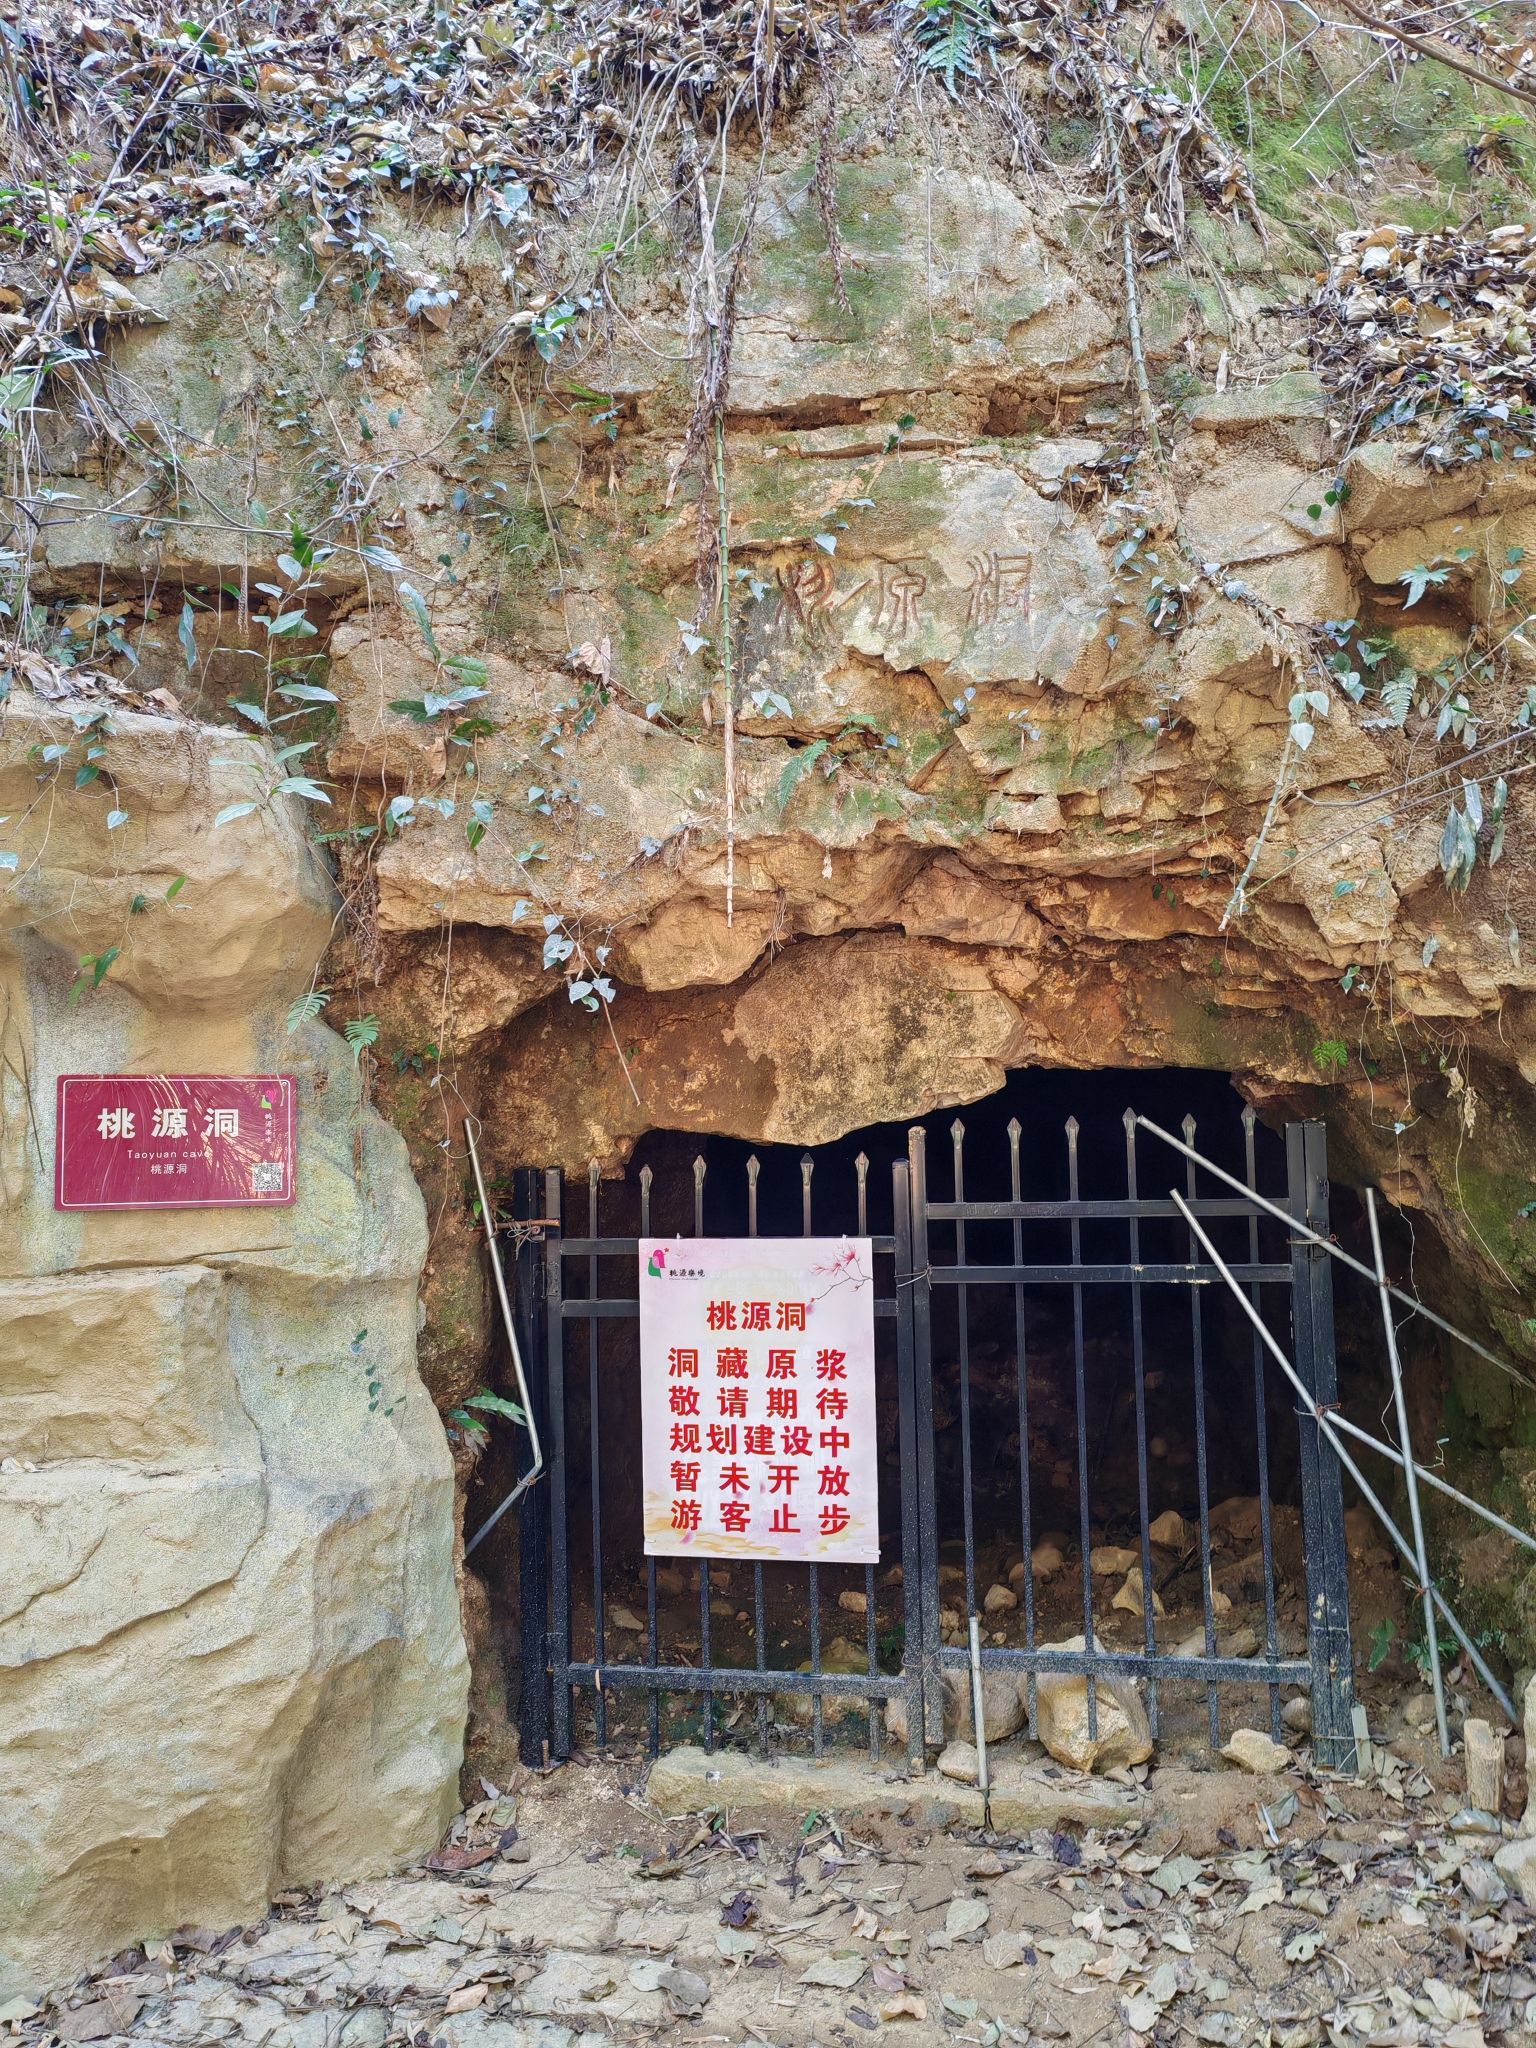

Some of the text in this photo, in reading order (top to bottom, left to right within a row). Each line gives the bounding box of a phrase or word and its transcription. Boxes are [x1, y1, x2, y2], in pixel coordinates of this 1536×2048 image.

[97, 1107, 239, 1139] 桃源洞
[127, 1149, 177, 1160] Taoyuan
[150, 1163, 187, 1174] 桃源洞
[706, 1301, 807, 1331] 桃源洞
[668, 1347, 848, 1380] 洞藏原浆
[668, 1385, 849, 1420] 敬请期待
[670, 1422, 851, 1458] 规划建设中
[670, 1460, 850, 1496] 暂未开放
[670, 1499, 850, 1535] 游客止步
